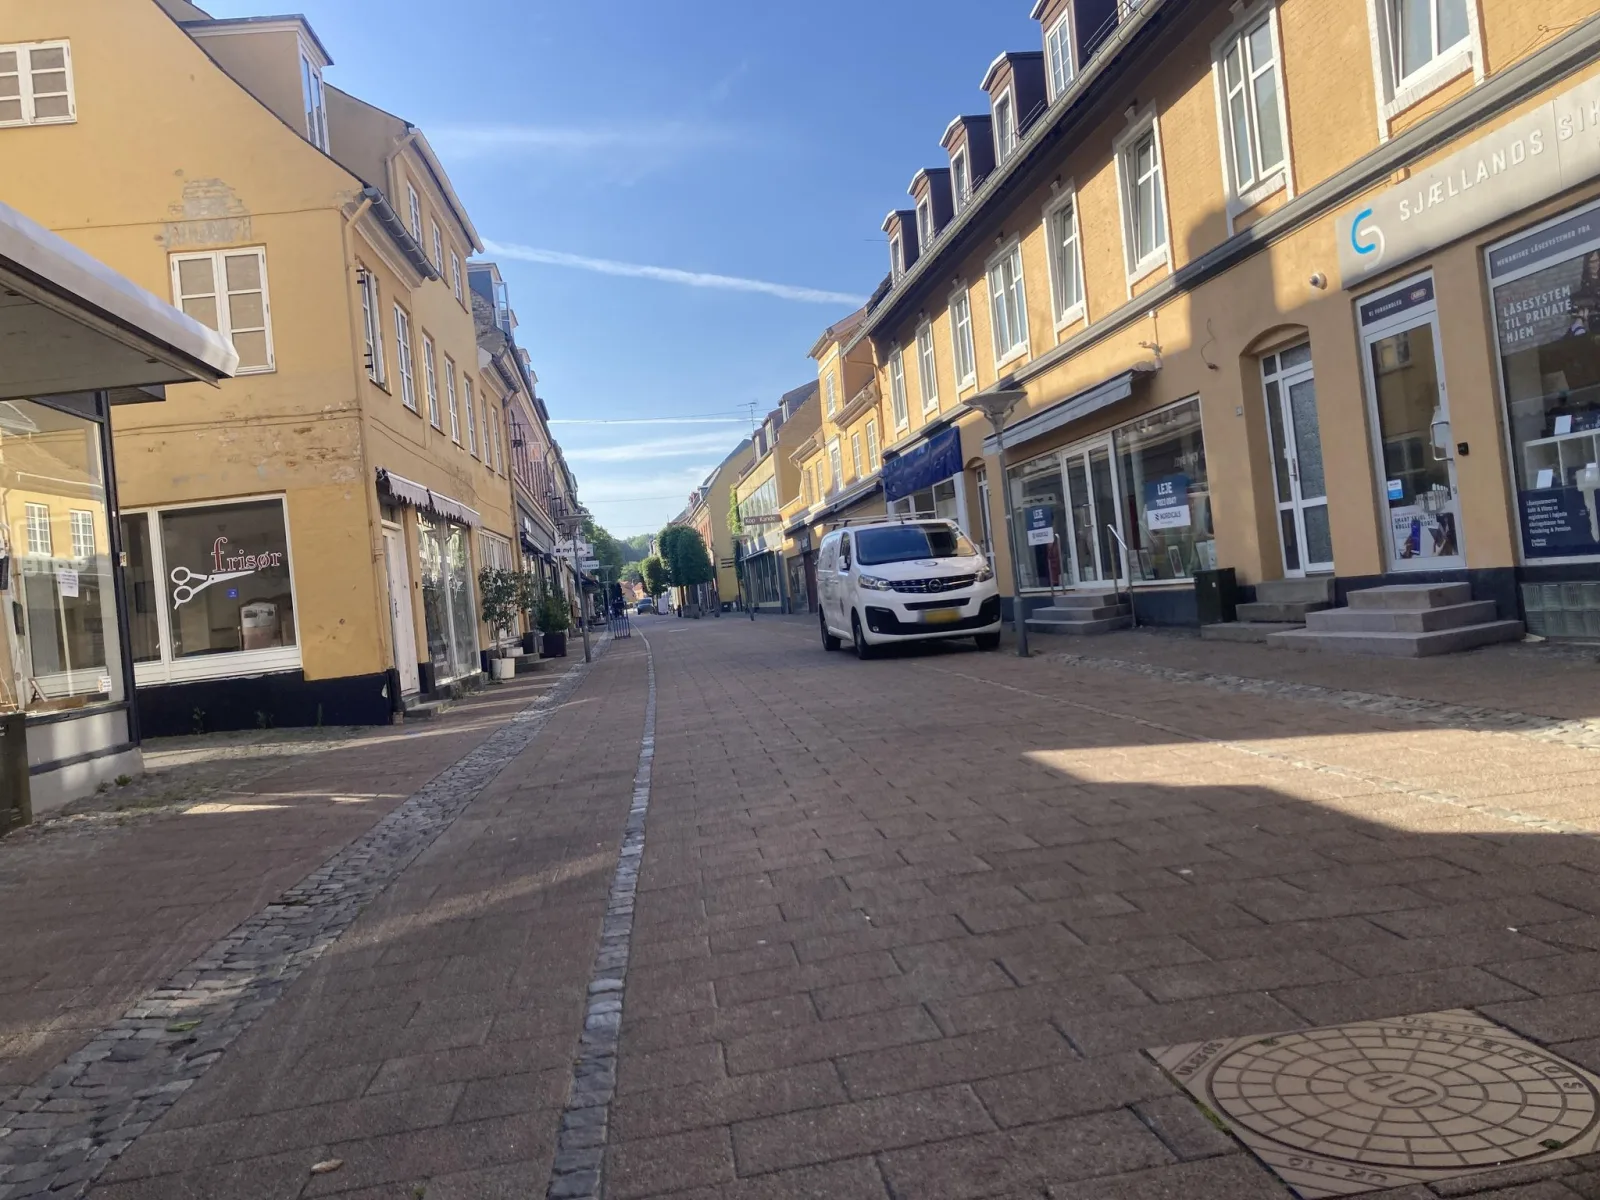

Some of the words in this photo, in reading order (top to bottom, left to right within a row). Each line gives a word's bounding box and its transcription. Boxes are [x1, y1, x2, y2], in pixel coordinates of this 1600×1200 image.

[1399, 129, 1545, 221] SJÆLLANDS
[1503, 284, 1571, 317] LÅSESYSTEM
[1504, 316, 1521, 330] TIL
[1525, 298, 1572, 324] PRIVATE
[1506, 325, 1534, 344] HJEM
[1157, 481, 1173, 496] LEJE
[211, 536, 282, 573] frisør
[1363, 1075, 1438, 1104] 40
